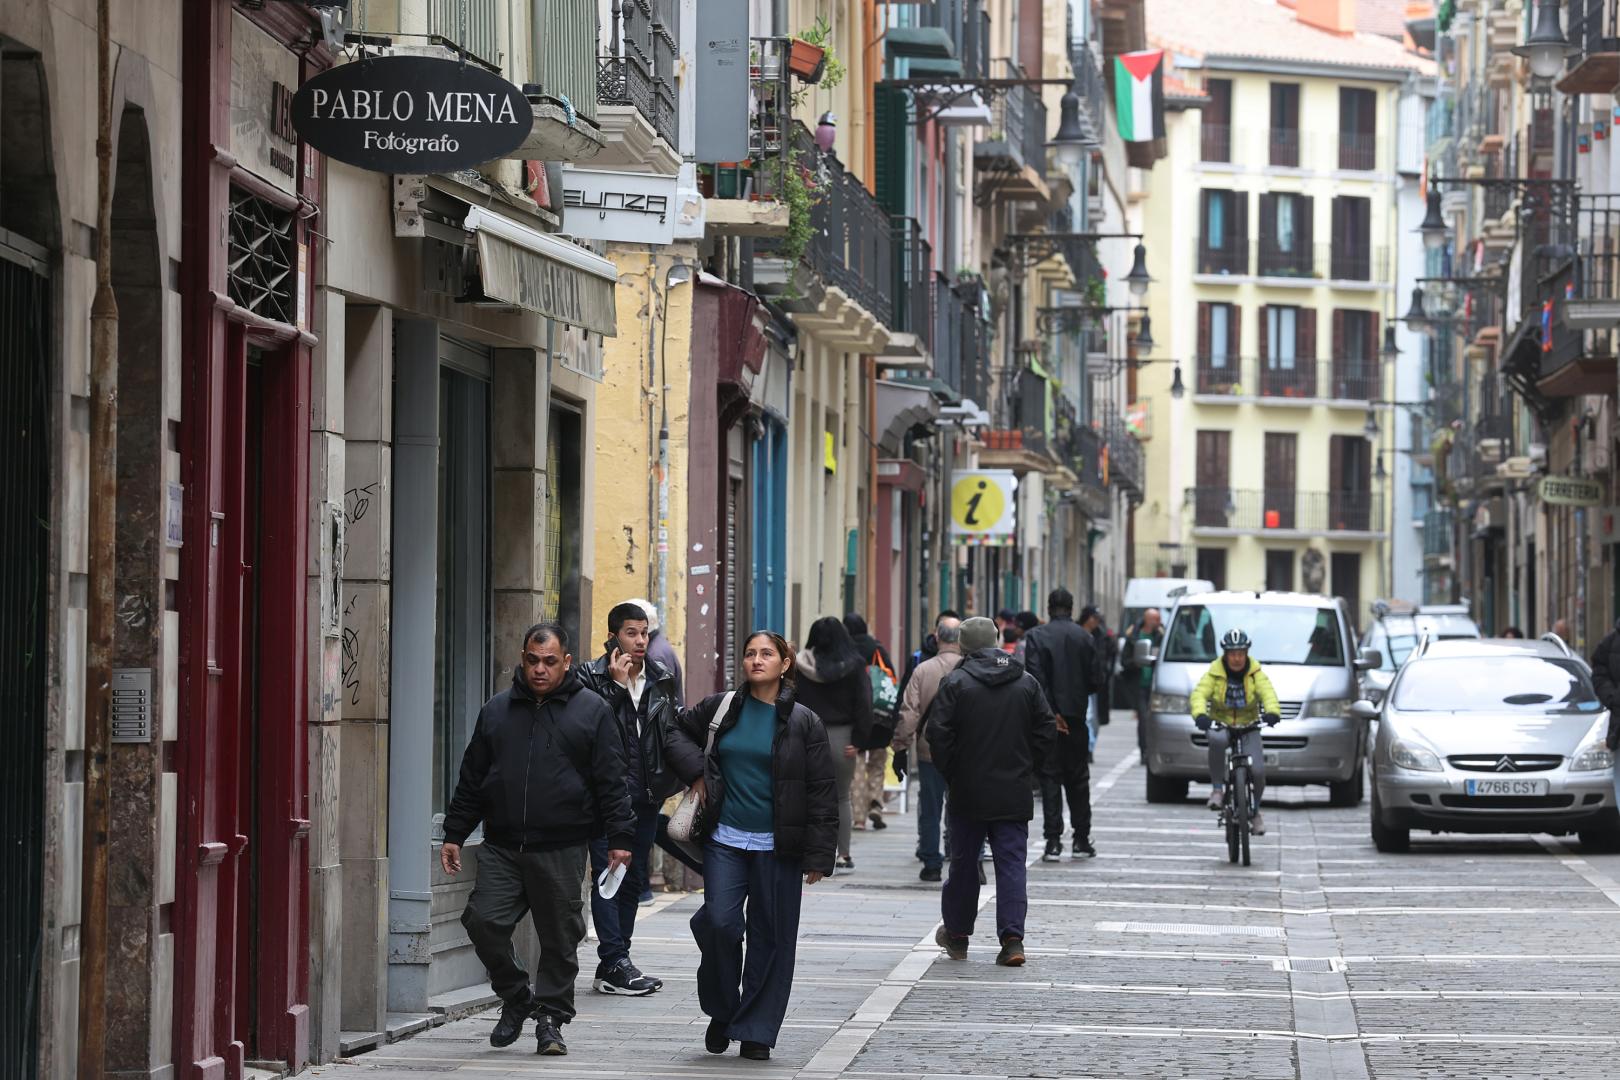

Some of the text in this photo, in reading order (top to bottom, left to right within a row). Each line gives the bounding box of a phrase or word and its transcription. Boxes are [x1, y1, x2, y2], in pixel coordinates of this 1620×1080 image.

[310, 88, 519, 125] PABLO MENA
[364, 130, 460, 155] Fotógrafo
[1476, 781, 1538, 794] 4766 CSY
